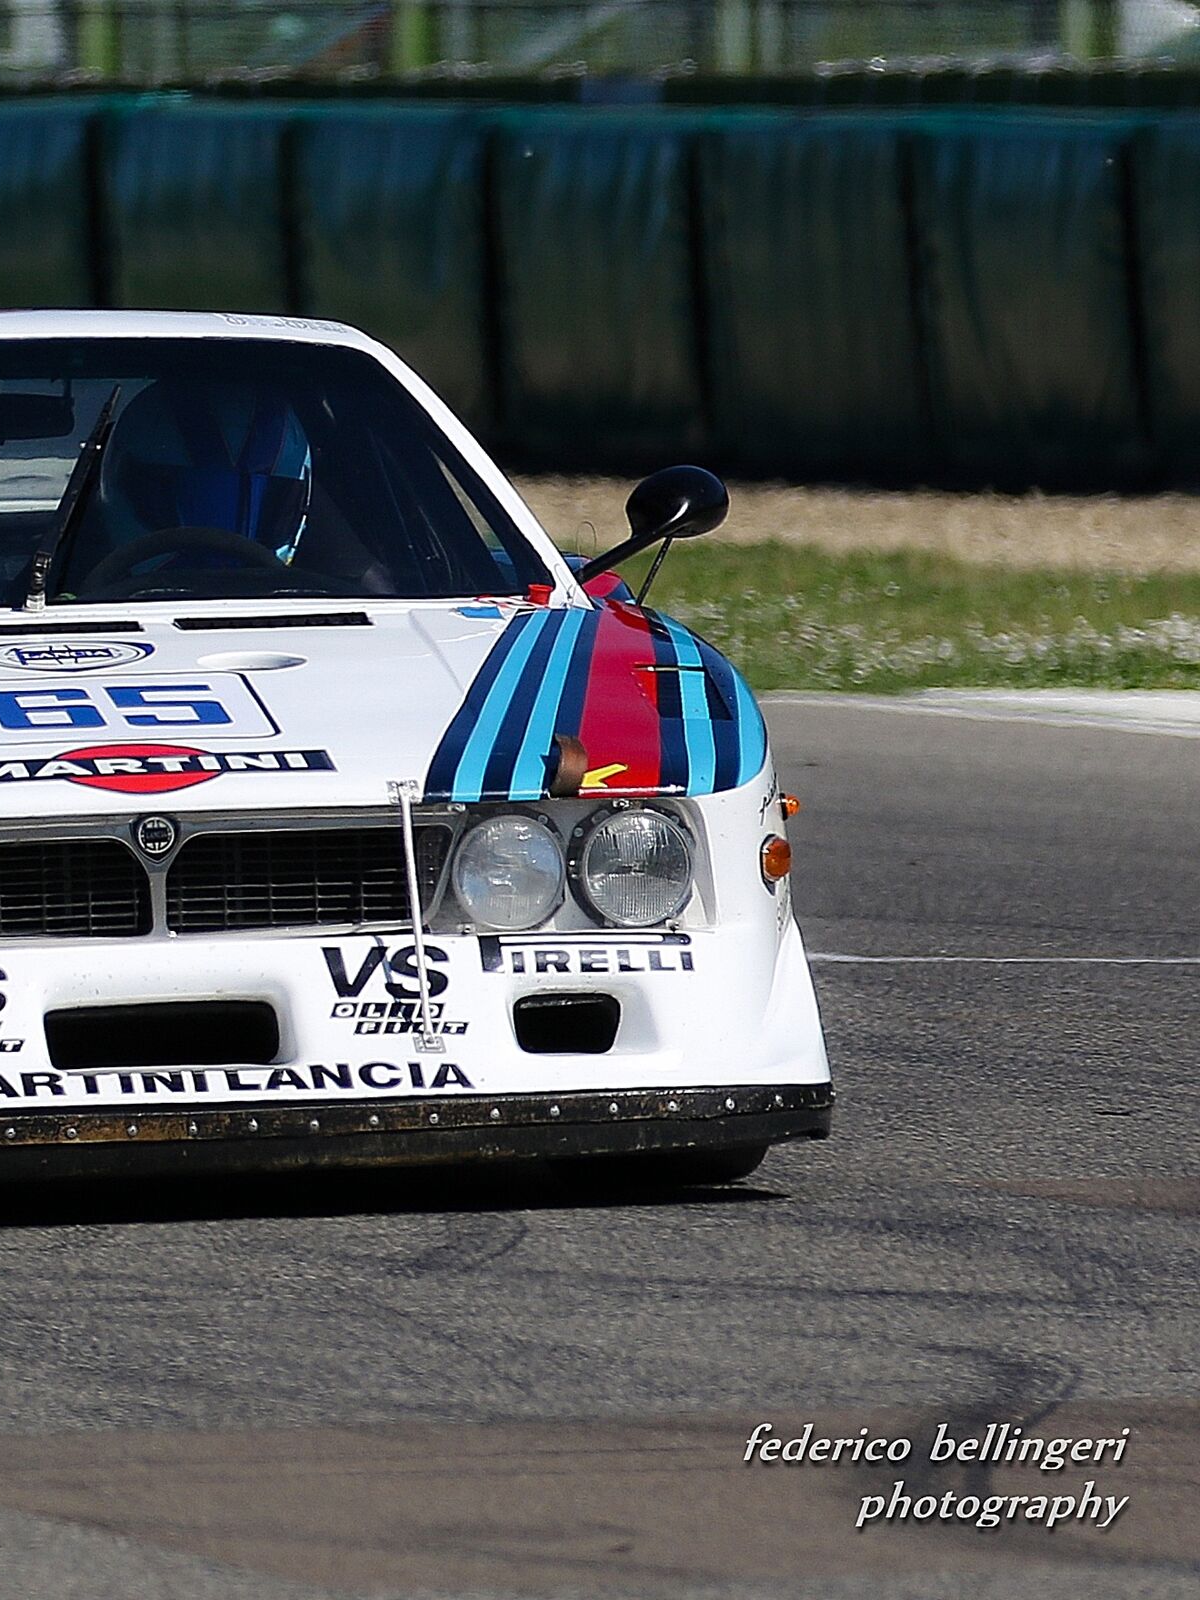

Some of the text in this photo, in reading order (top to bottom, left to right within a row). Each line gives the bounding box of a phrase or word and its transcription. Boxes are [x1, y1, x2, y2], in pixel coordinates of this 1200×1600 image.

[20, 649, 111, 661] LANCIA
[478, 932, 695, 974] PIRELLI
[321, 945, 449, 998] VS
[223, 1062, 476, 1092] LANCIA
